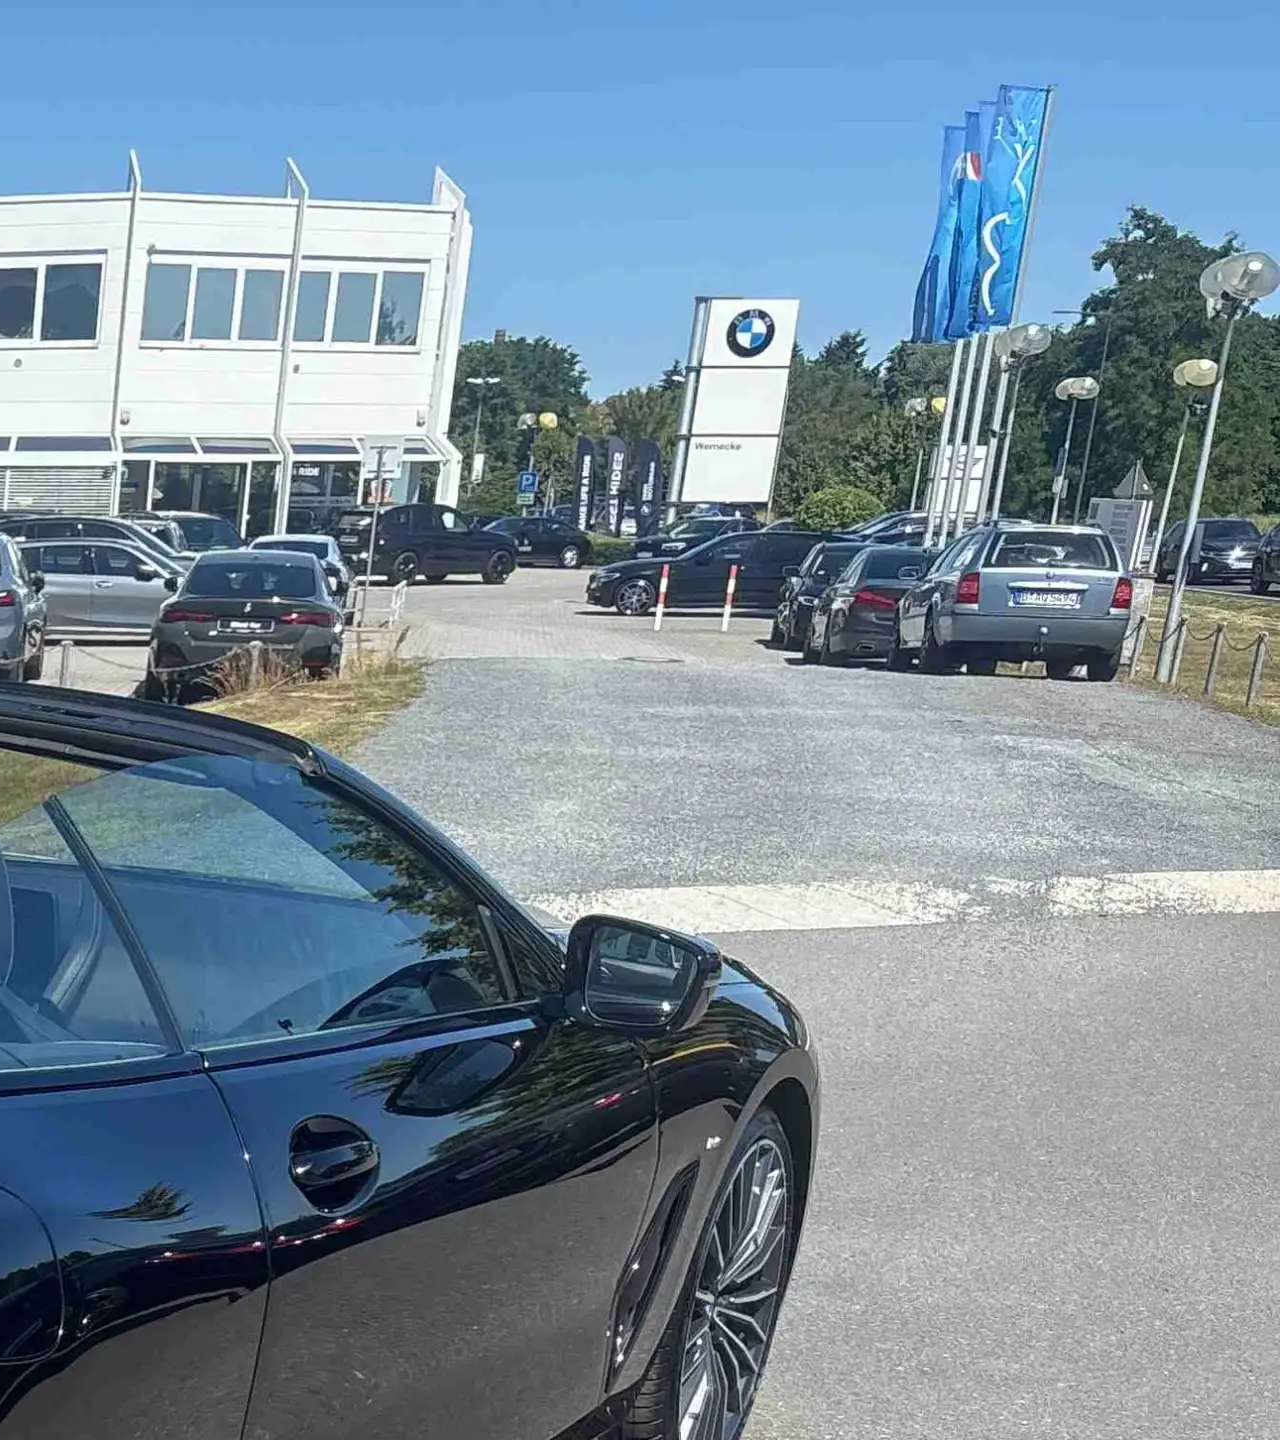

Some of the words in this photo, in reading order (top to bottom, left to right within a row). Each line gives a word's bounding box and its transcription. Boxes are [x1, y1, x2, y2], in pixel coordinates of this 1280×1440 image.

[695, 442, 741, 451] Wernecke
[298, 467, 320, 476] RIDE
[521, 474, 533, 490] P
